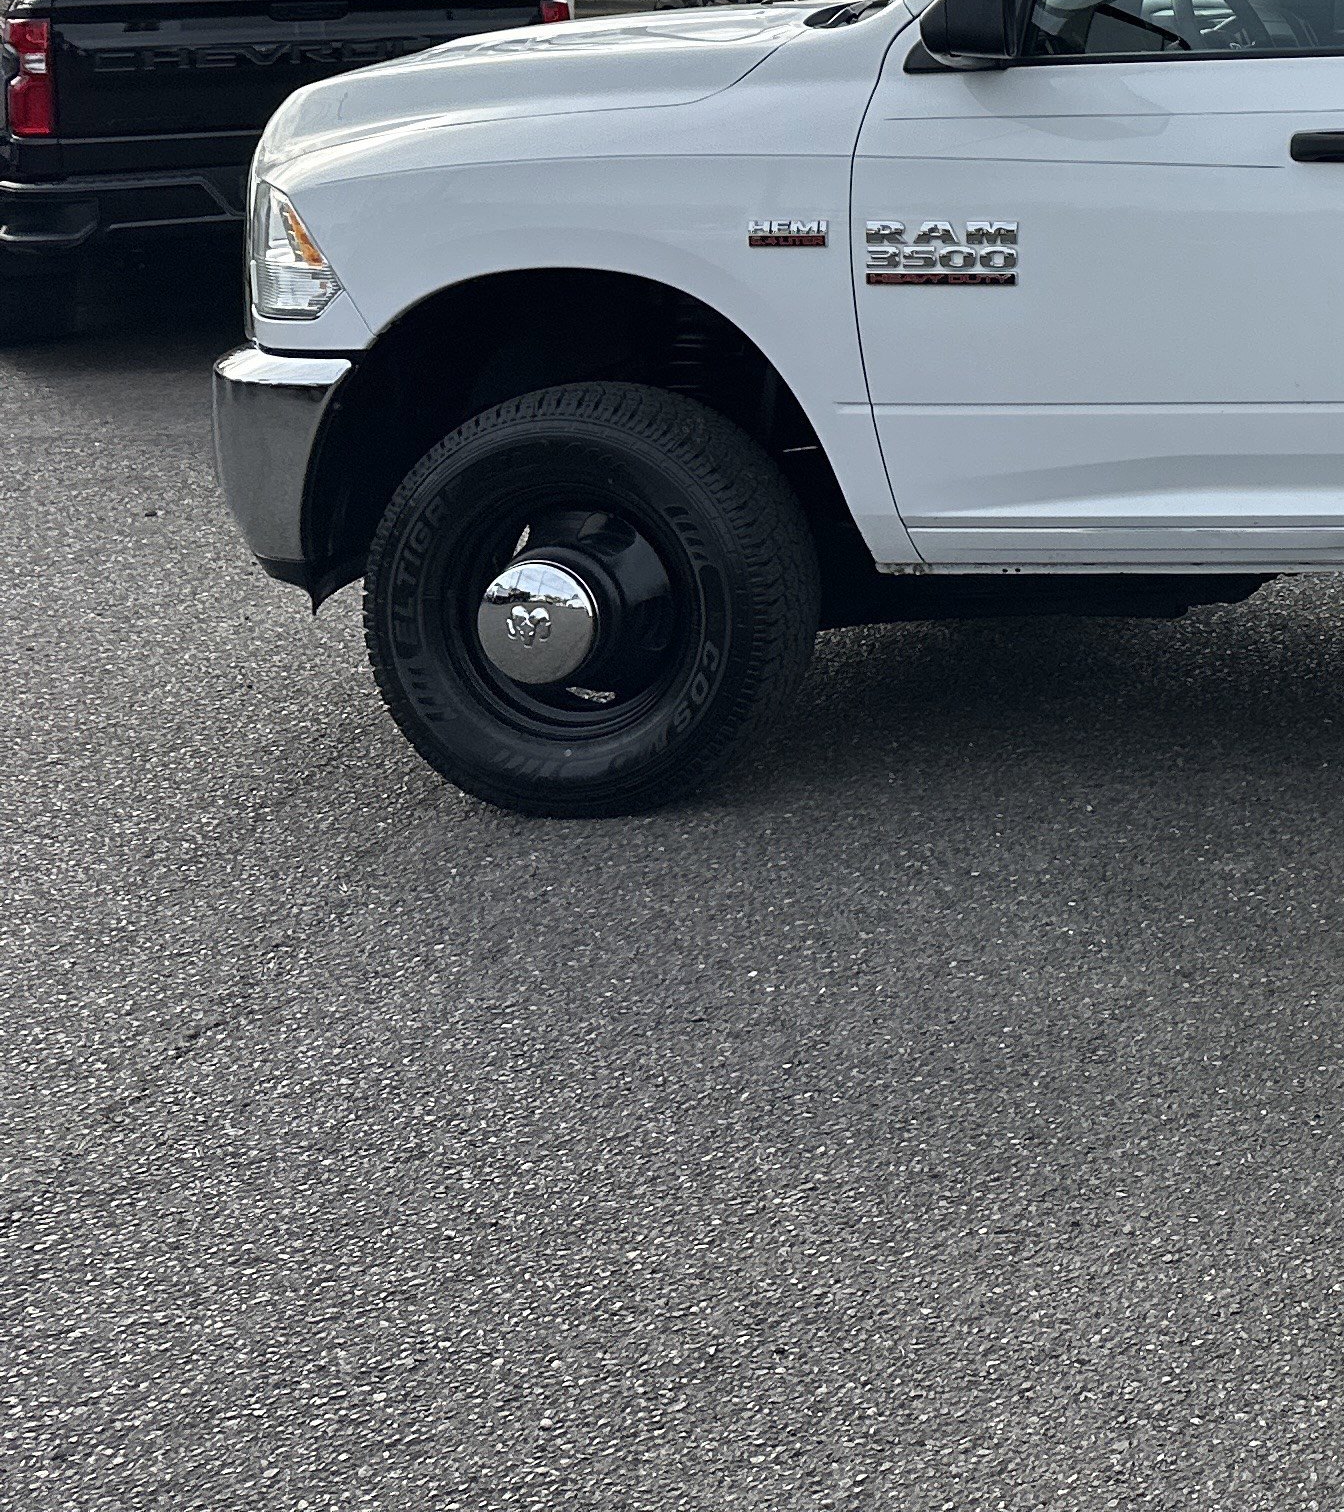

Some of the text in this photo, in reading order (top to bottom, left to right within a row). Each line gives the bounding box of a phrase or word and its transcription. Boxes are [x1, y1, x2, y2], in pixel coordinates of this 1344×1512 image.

[748, 219, 828, 235] HEMI
[865, 221, 1018, 245] RAM
[865, 246, 1018, 269] 3500
